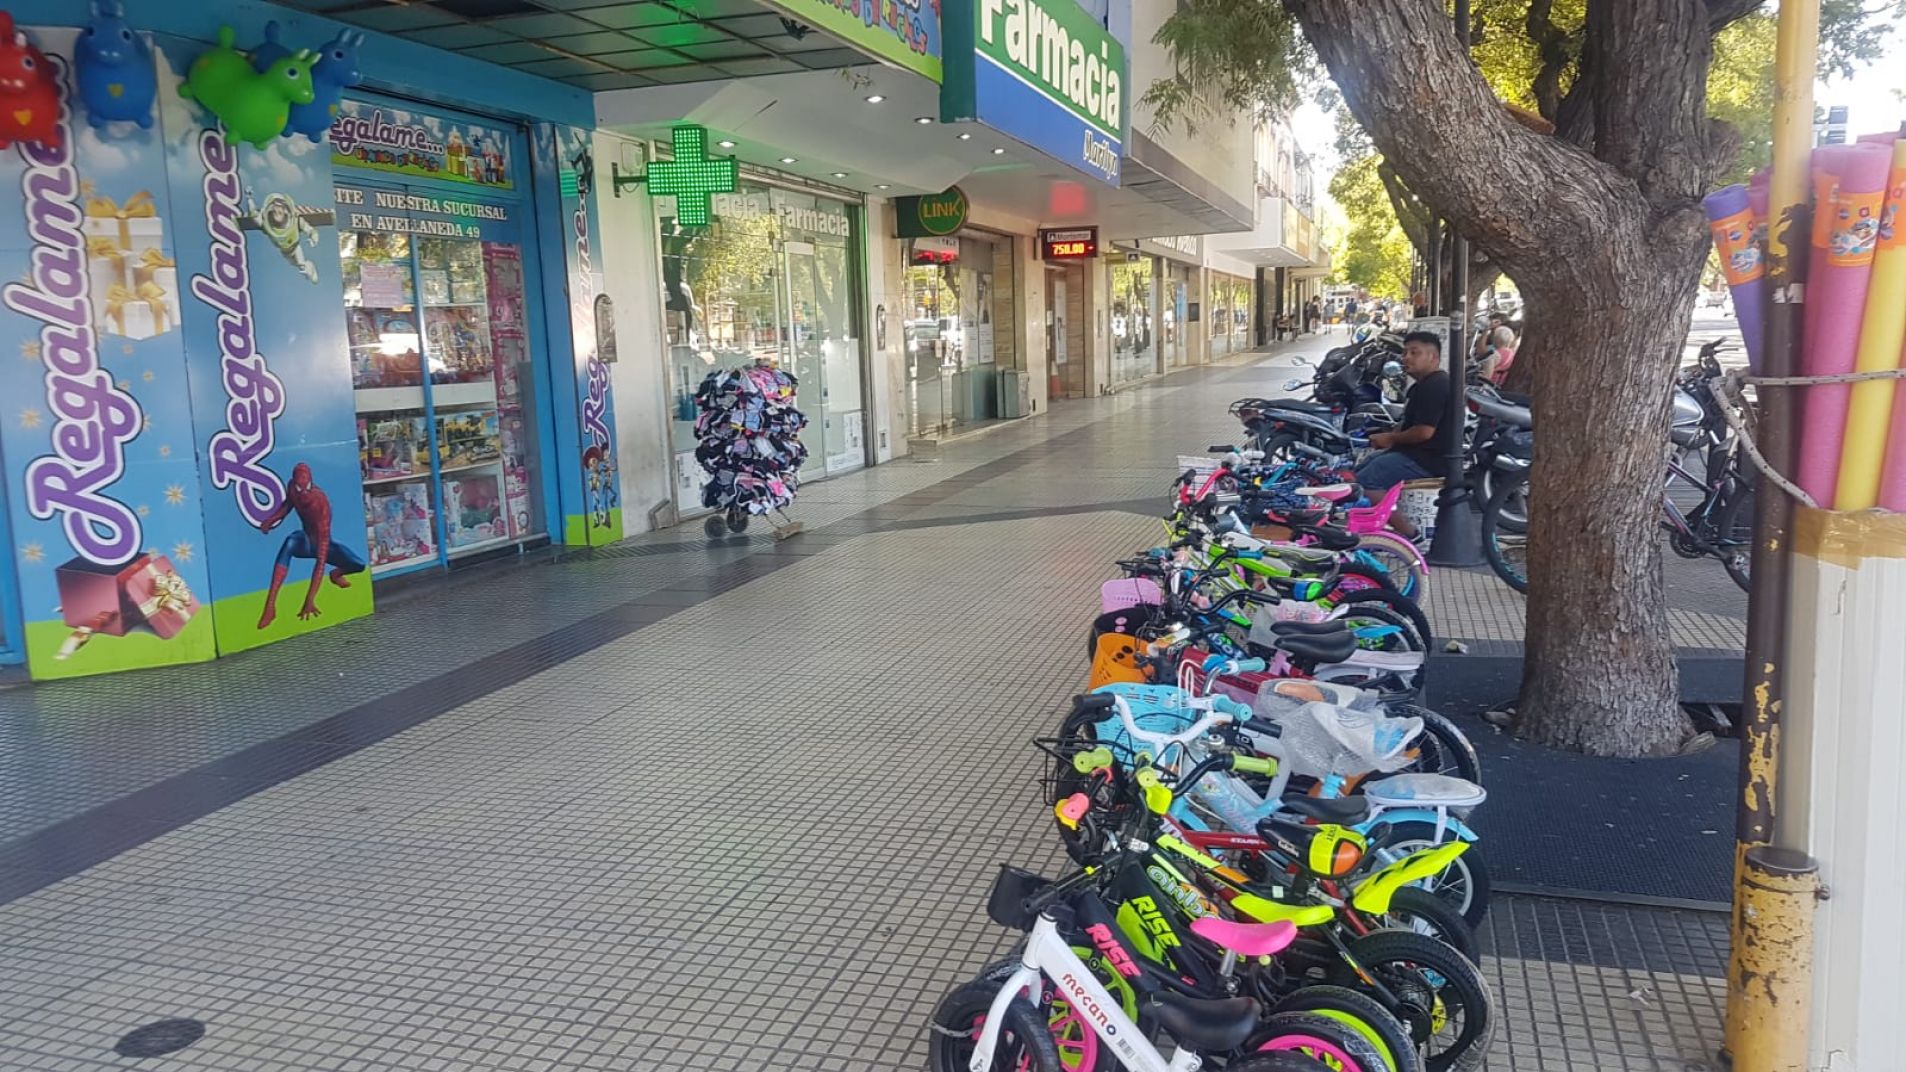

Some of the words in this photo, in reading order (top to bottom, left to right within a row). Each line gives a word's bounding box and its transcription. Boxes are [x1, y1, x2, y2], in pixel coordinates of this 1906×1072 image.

[335, 188, 363, 204] ITE
[376, 192, 440, 213] NUESTRA
[443, 200, 507, 220] SUCURSAL
[772, 198, 850, 237] Farmacia
[922, 200, 961, 219] LINK
[351, 213, 372, 229] EN
[465, 226, 481, 239] 49
[1052, 243, 1085, 256] 750.00
[1132, 895, 1182, 948] RISE
[1084, 923, 1142, 979] RISE
[1061, 972, 1118, 1036] mecano
